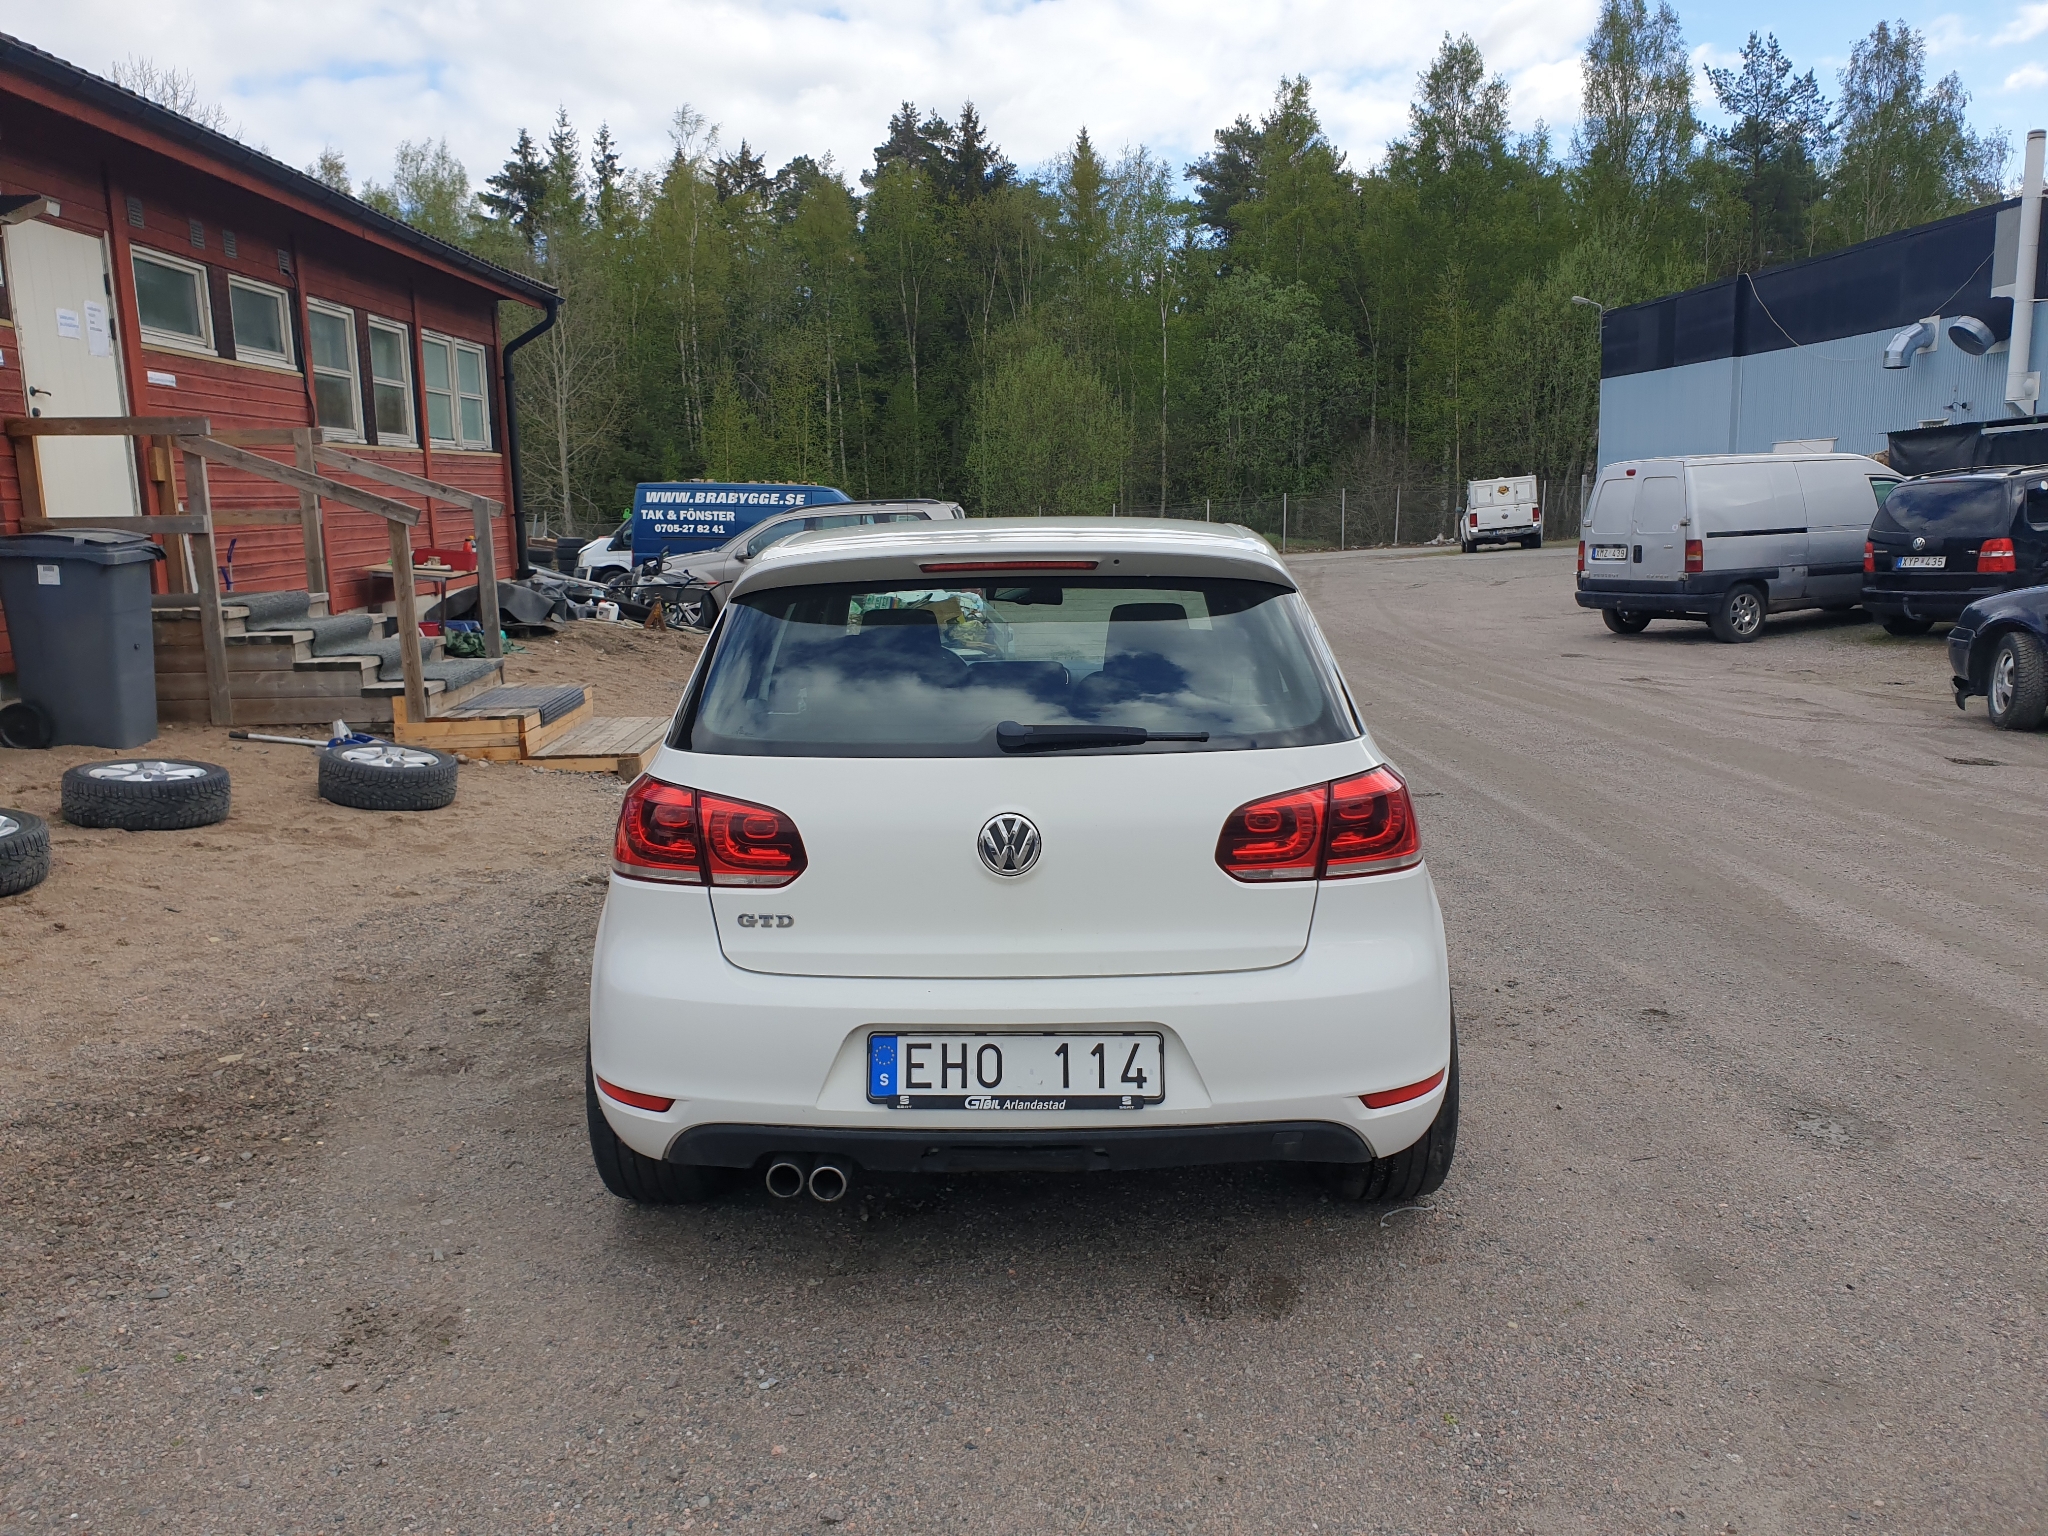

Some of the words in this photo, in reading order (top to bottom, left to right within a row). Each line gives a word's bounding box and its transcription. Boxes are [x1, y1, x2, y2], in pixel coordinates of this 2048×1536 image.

[645, 491, 806, 506] WWW.BRABYGGE.SE
[640, 509, 665, 520] TAK
[667, 510, 677, 521] &
[679, 508, 735, 522] FÖNSTER
[655, 524, 695, 533] 0705-27
[696, 524, 710, 534] 82
[711, 524, 725, 534] 41
[1596, 549, 1609, 558] XMZ
[1611, 549, 1625, 558] 439
[1902, 557, 1920, 567] XYP
[1925, 557, 1943, 567] 435
[737, 912, 795, 928] GTD
[906, 1042, 1003, 1089] EHO
[1054, 1042, 1148, 1089] 114
[879, 1073, 889, 1086] S
[1003, 1098, 1067, 1110] Arlandastad
